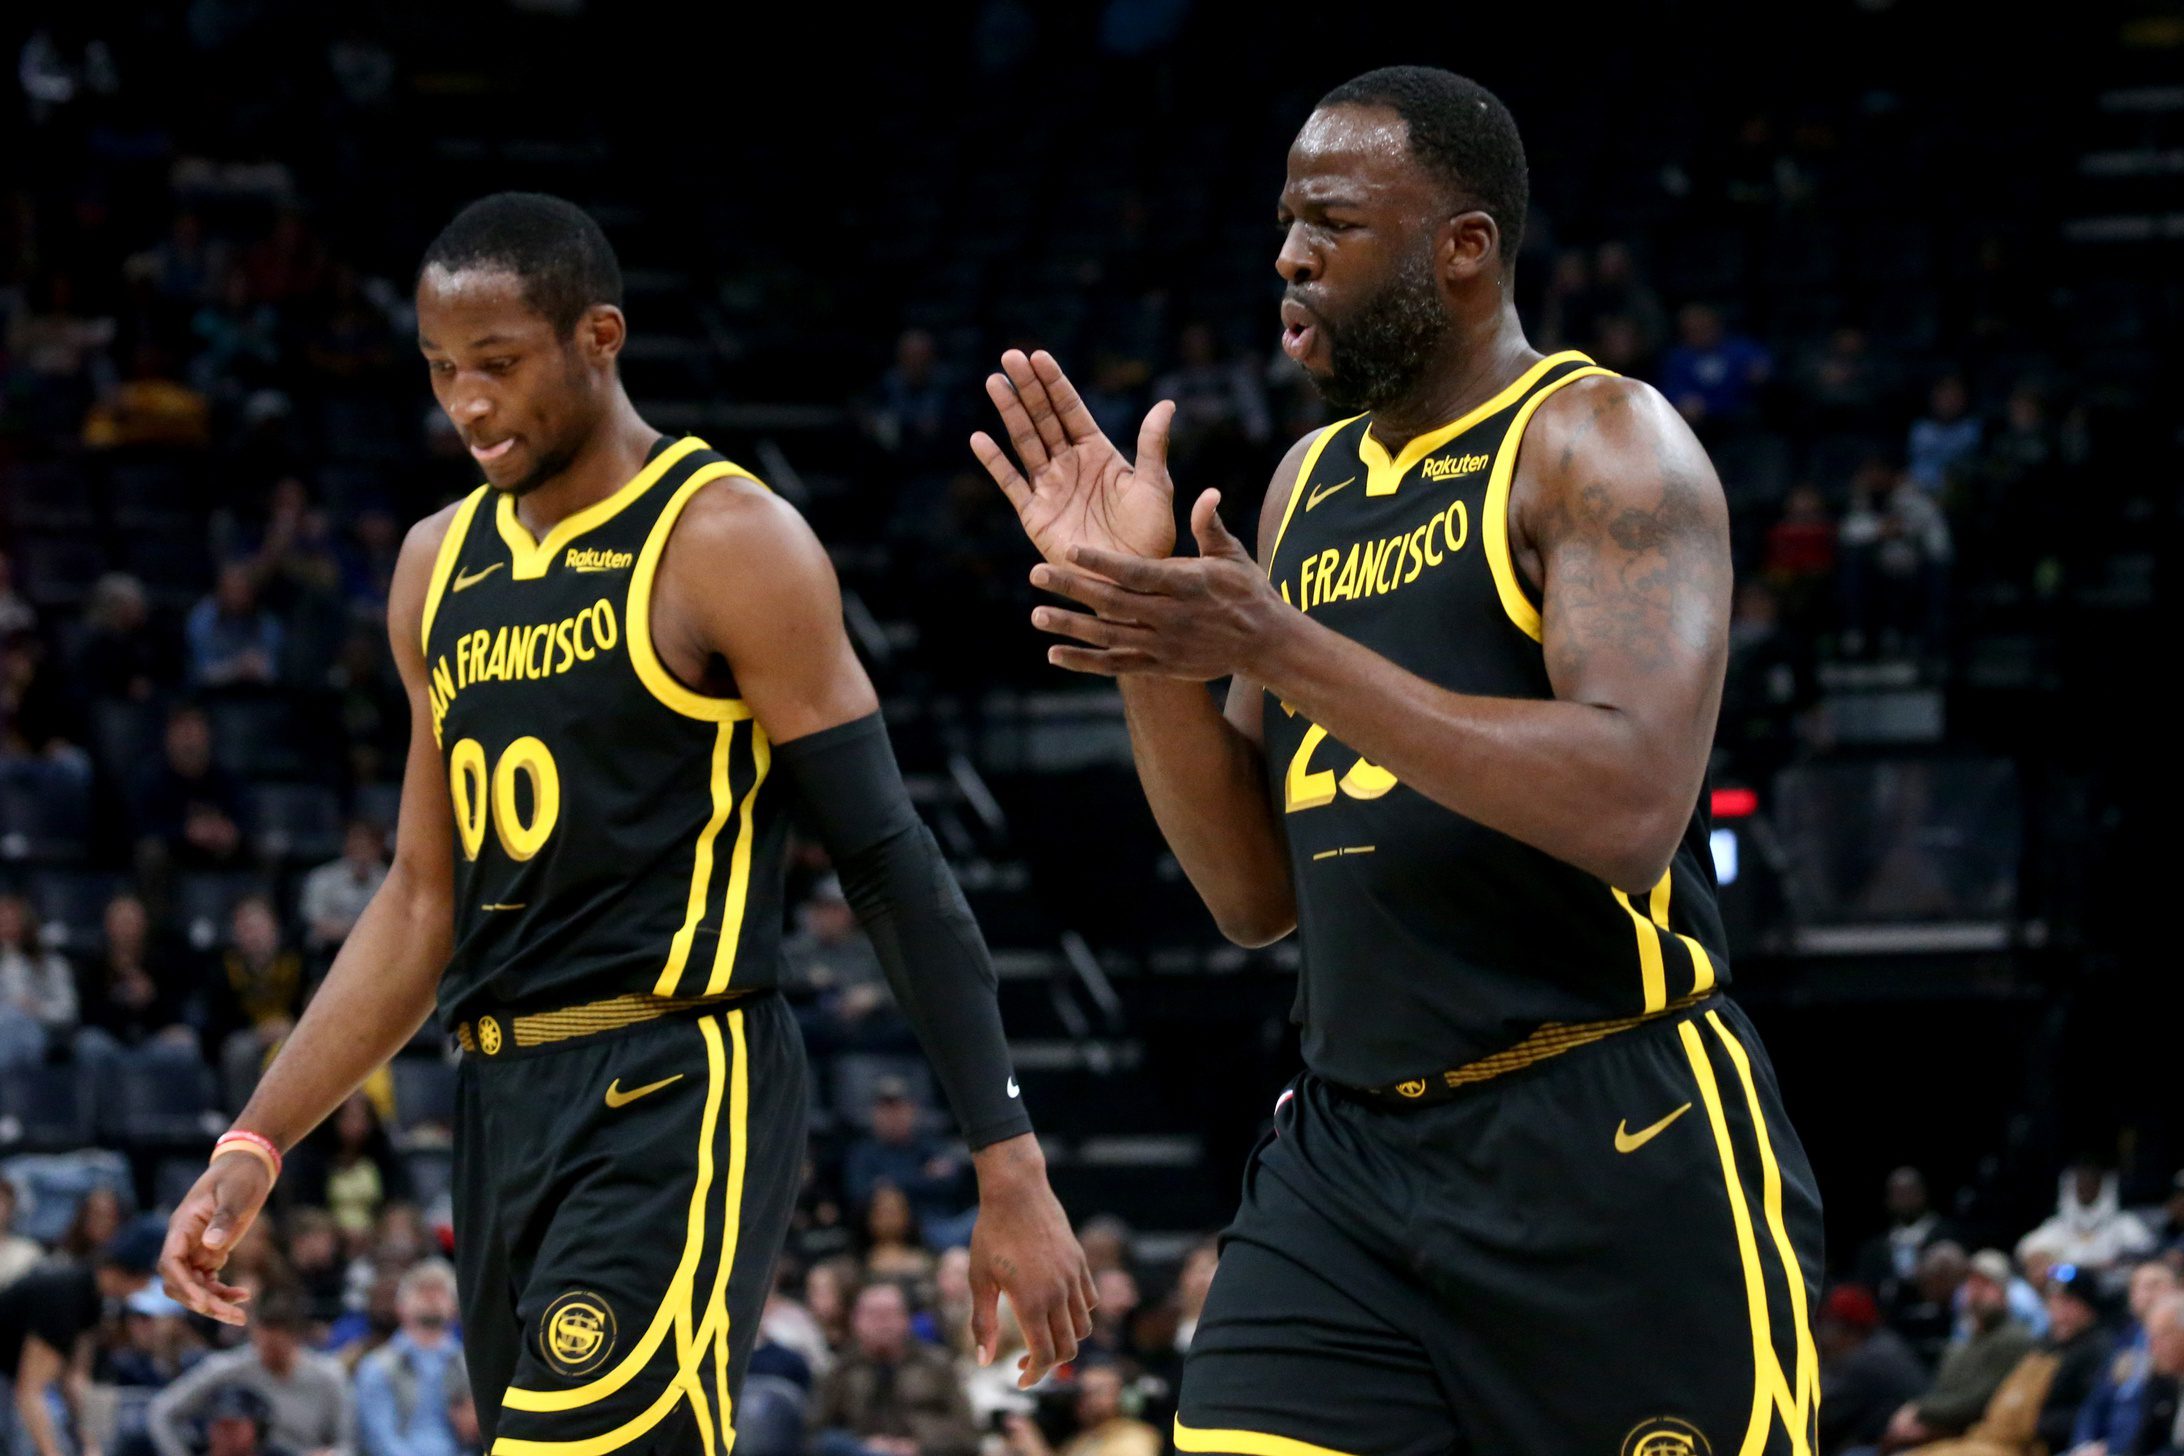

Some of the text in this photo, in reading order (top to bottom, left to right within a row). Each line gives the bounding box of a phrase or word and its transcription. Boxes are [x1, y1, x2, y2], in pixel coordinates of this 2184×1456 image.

[1421, 453, 1489, 481] Rakuten
[565, 547, 633, 571] Rakuten
[1301, 500, 1468, 613] FRANCISCO
[457, 598, 617, 689] FRANCISCO
[450, 736, 560, 861] 00
